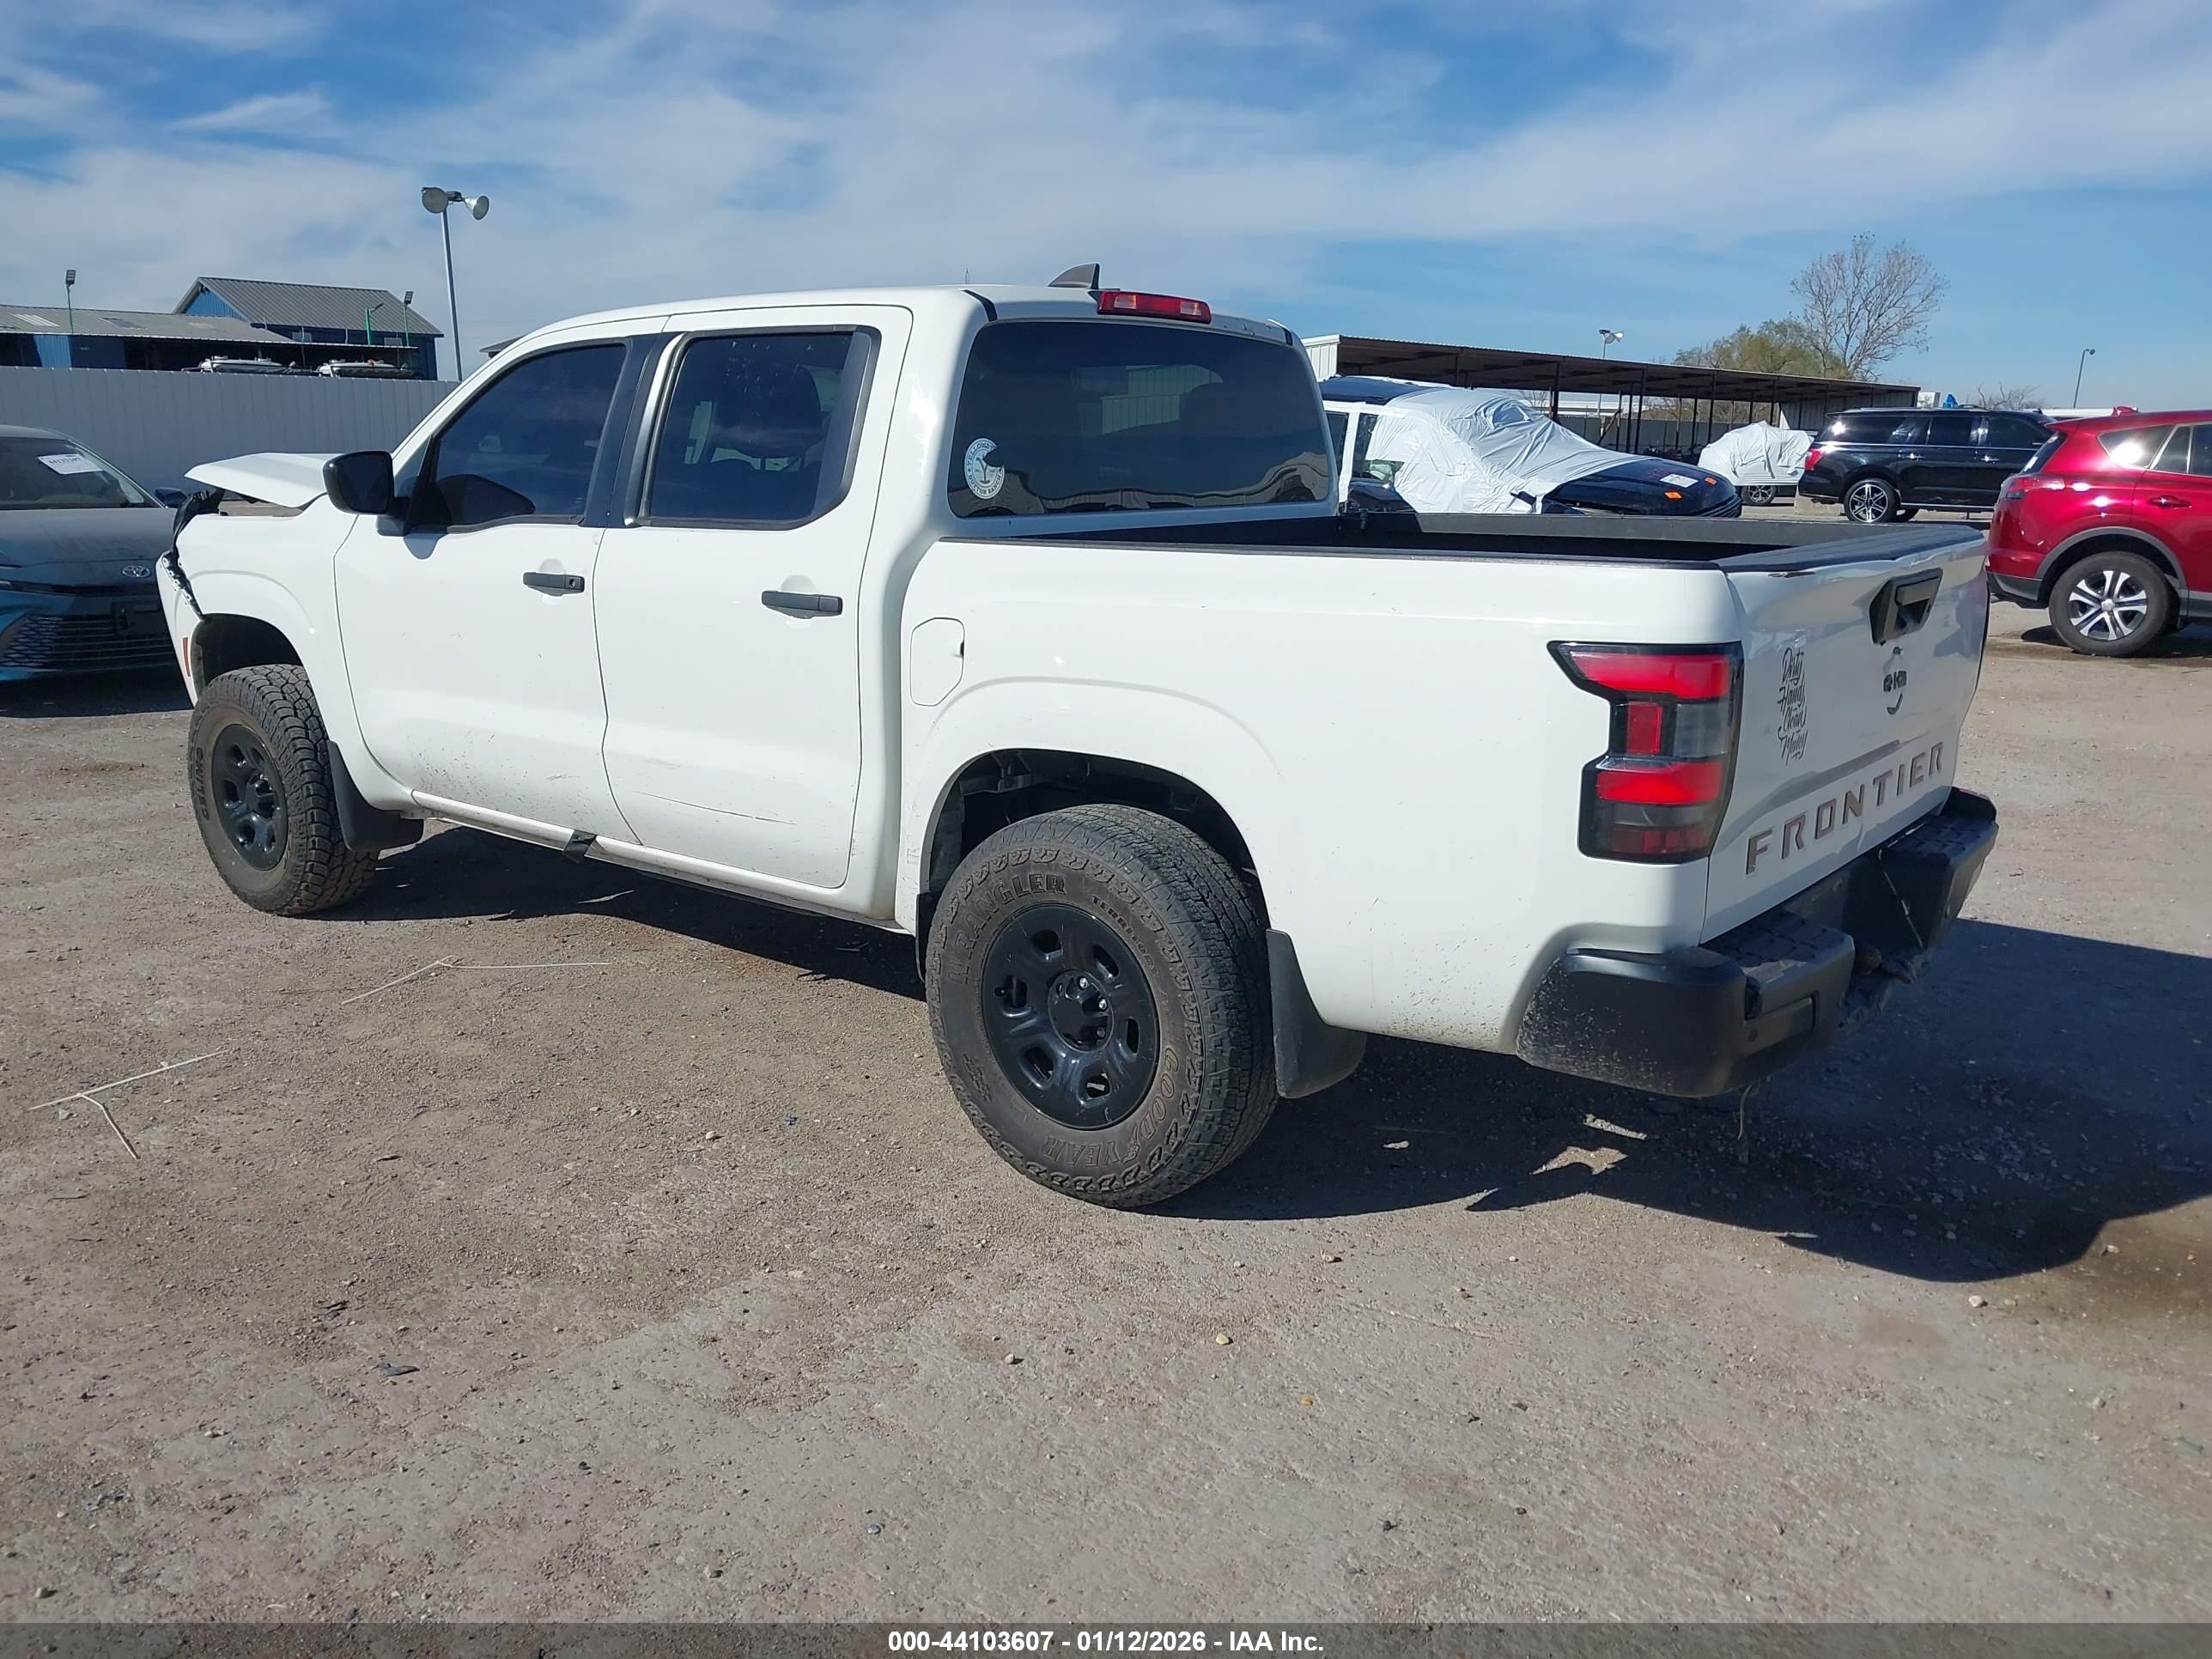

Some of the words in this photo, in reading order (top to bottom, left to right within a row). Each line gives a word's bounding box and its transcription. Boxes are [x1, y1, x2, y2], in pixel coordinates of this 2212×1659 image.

[988, 474, 1001, 494] RANCH
[1782, 647, 1804, 686] Dirty
[1778, 726, 1808, 766] Money
[1746, 741, 1943, 875] FRONTIER
[947, 872, 1066, 985] WRANGLER
[1042, 1046, 1179, 1168] GOODYEAR
